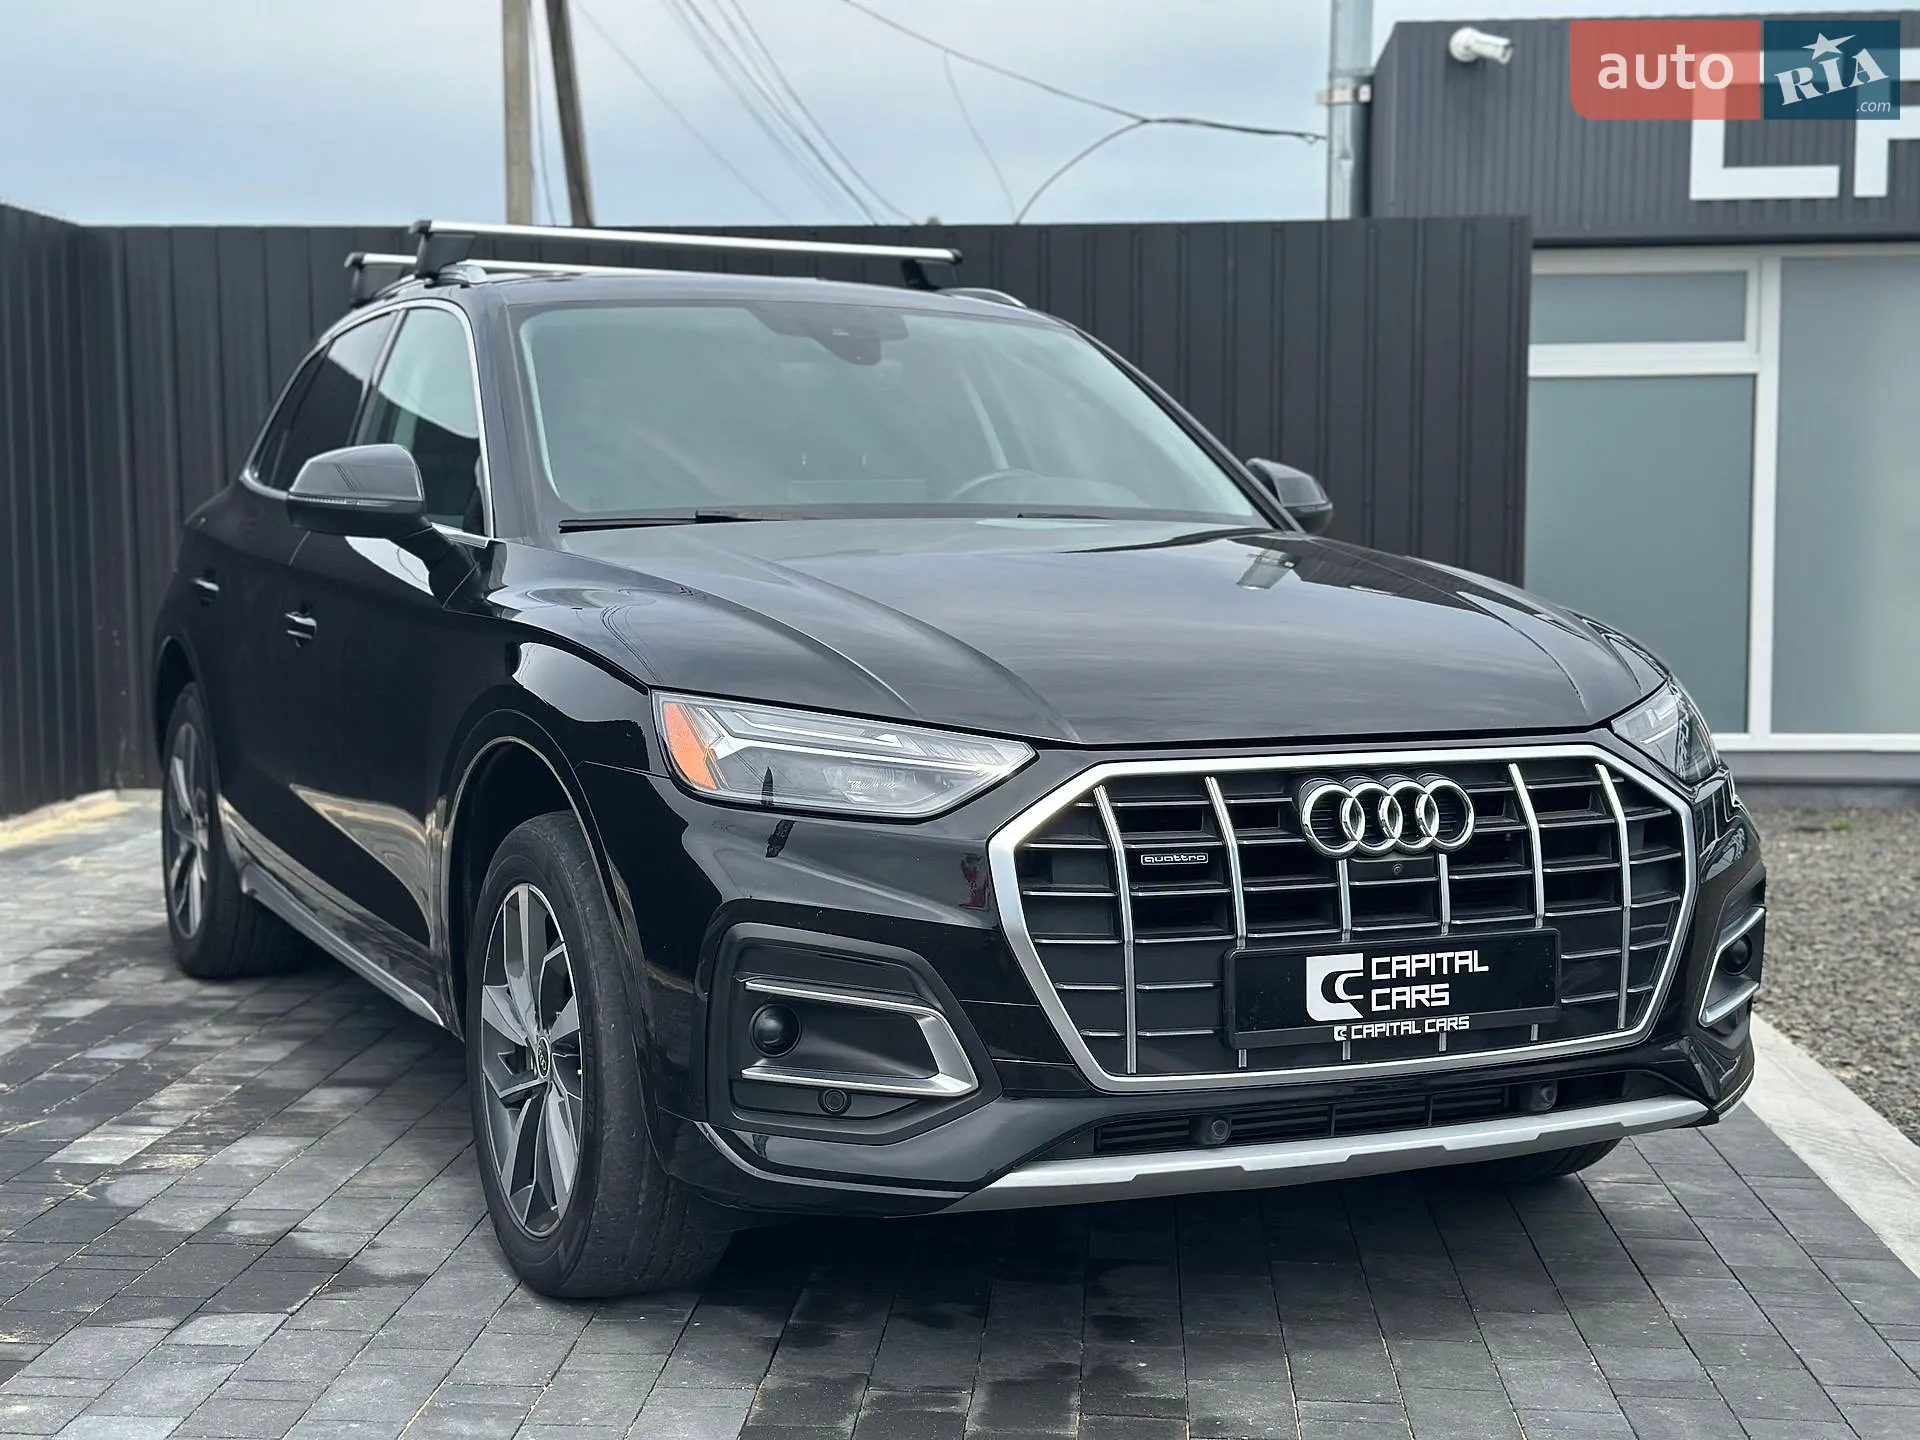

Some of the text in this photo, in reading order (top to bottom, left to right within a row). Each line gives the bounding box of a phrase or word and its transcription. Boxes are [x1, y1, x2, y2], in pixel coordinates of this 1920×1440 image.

[1144, 854, 1206, 863] quattro
[1371, 950, 1489, 980] CAPITAL
[1371, 983, 1450, 1012] CARS
[1351, 1021, 1421, 1039] CAPITAL
[1424, 1016, 1470, 1032] CARS
